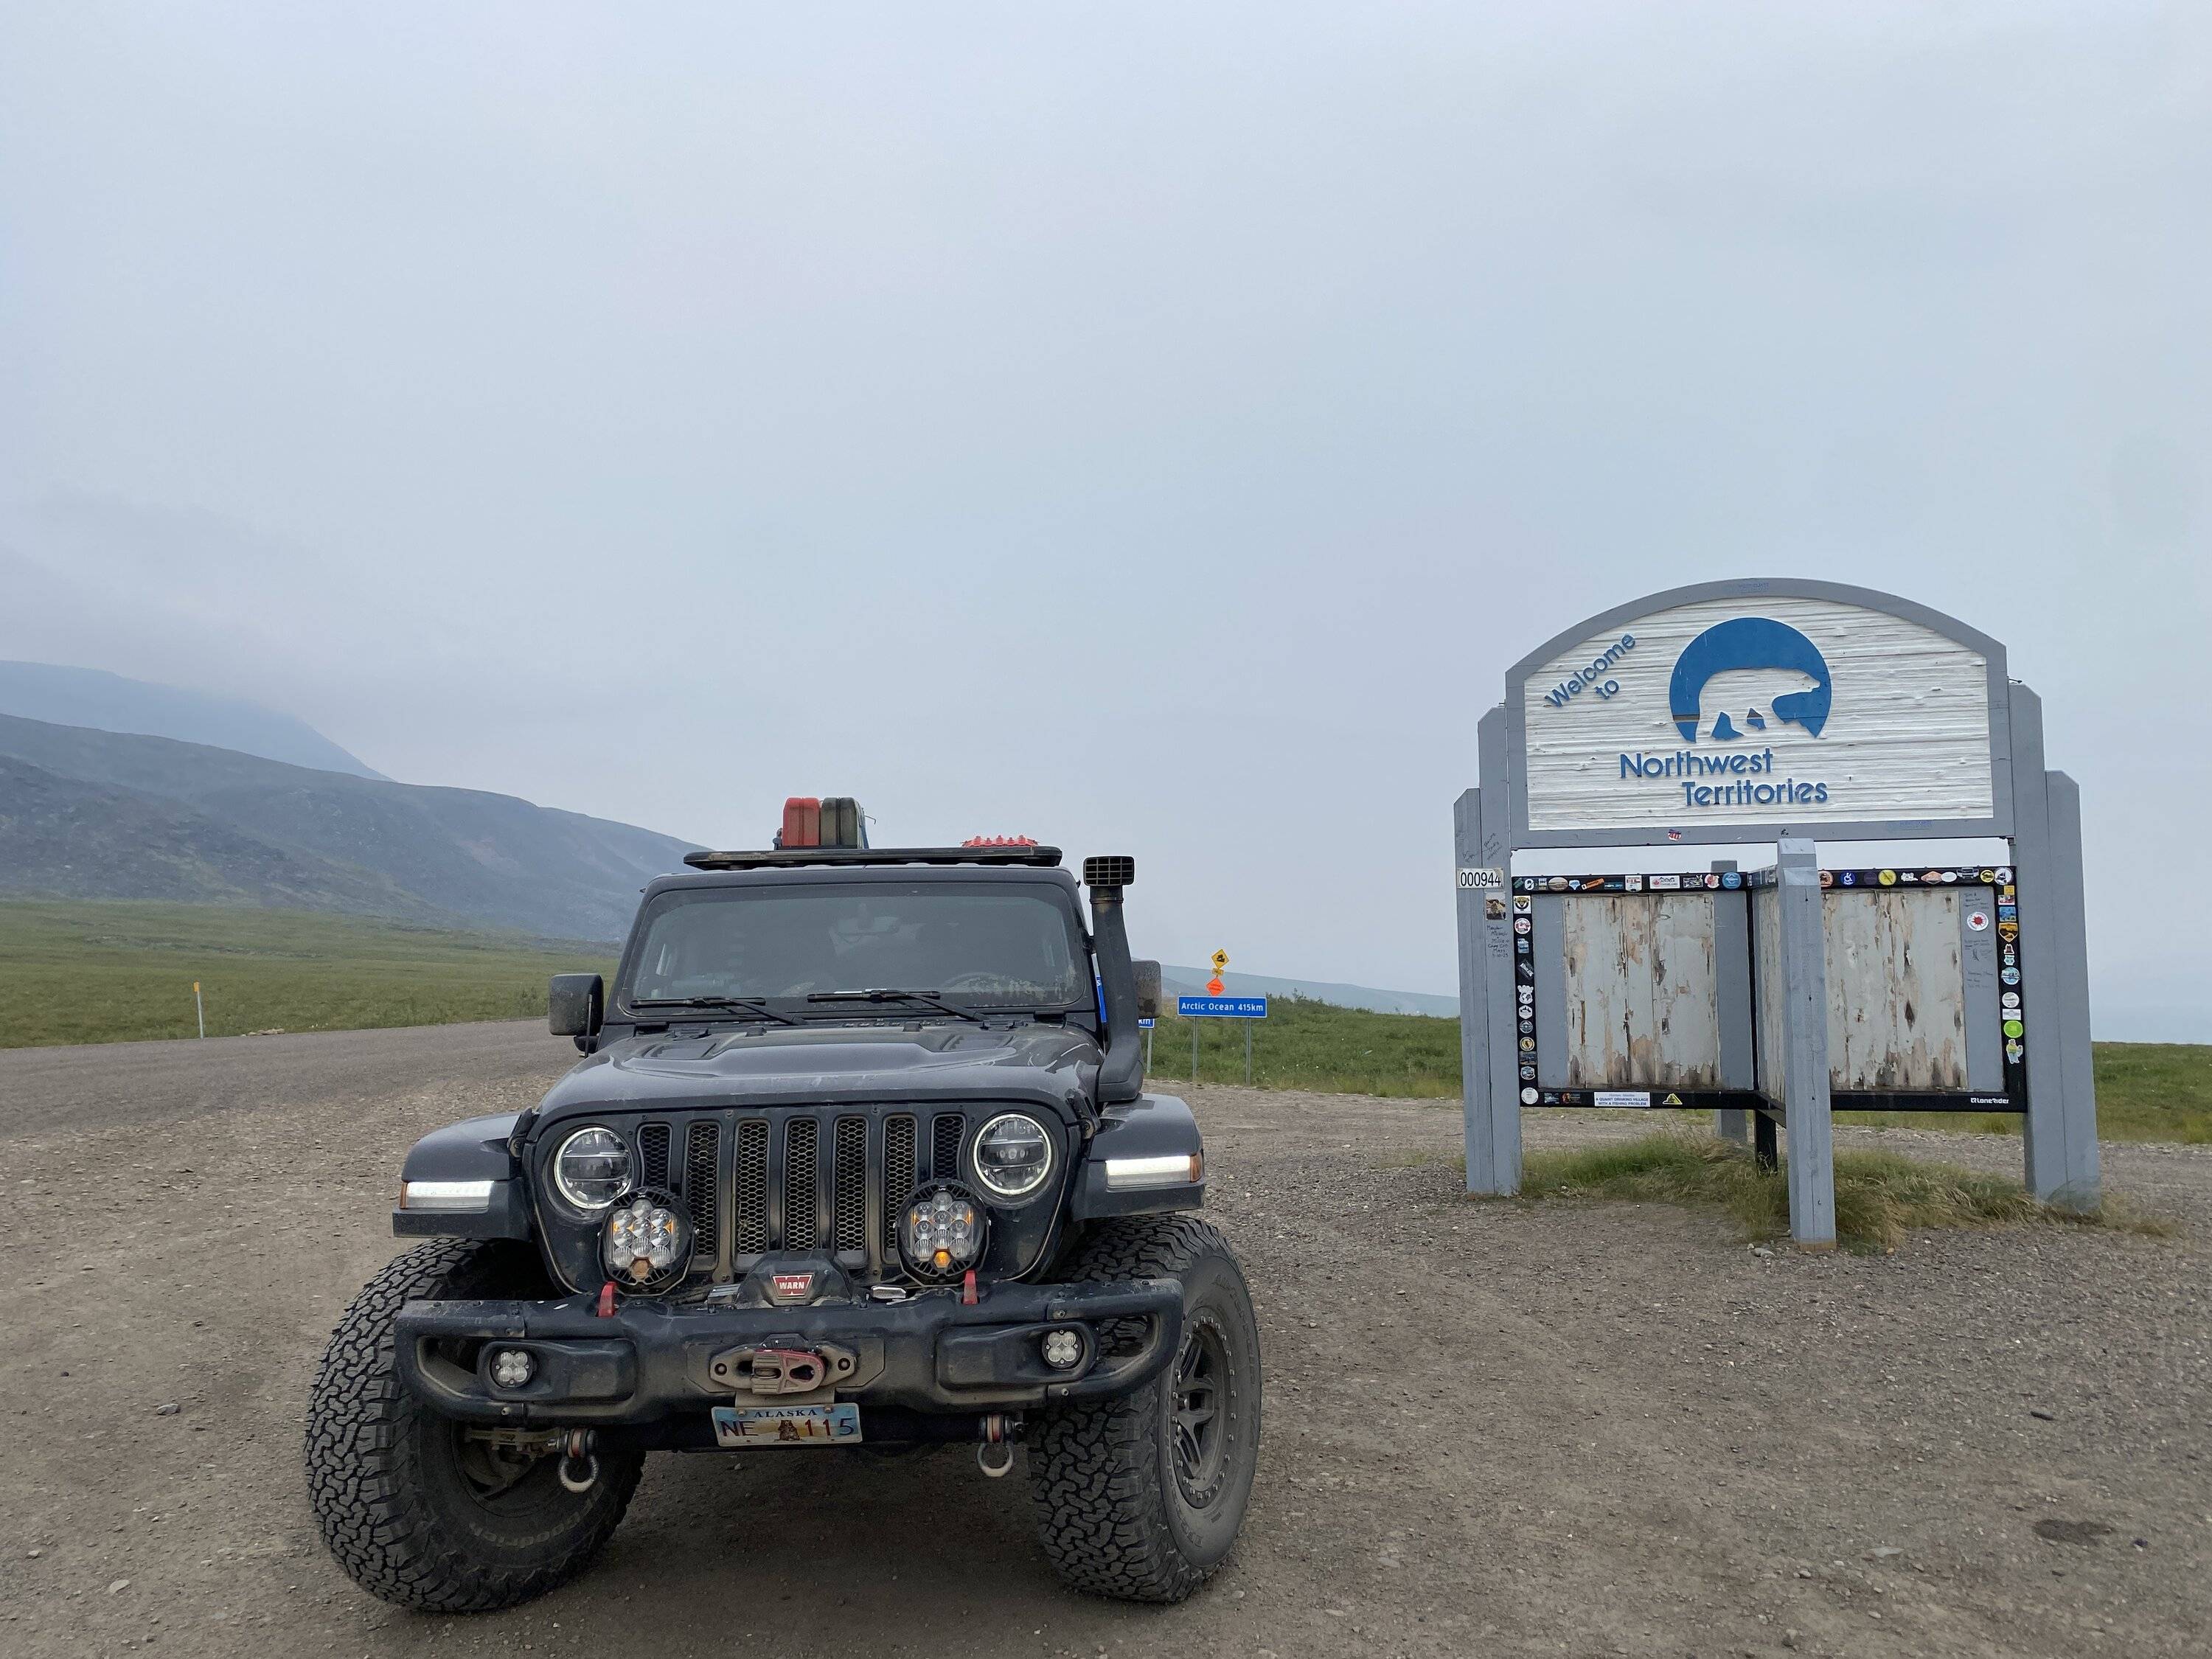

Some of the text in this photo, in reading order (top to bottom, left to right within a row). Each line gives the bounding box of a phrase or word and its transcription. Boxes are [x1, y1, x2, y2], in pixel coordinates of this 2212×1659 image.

[1544, 634, 1636, 708] Welcome
[1594, 680, 1619, 700] to
[1620, 748, 1773, 778] Northwest
[1682, 778, 1828, 806] Territories
[1461, 872, 1501, 886] 000944
[1181, 1002, 1263, 1012] Arctic Ocean 415km
[779, 1281, 804, 1290] WARN
[754, 1409, 818, 1418] ALASKA
[720, 1417, 856, 1437] NE 115
